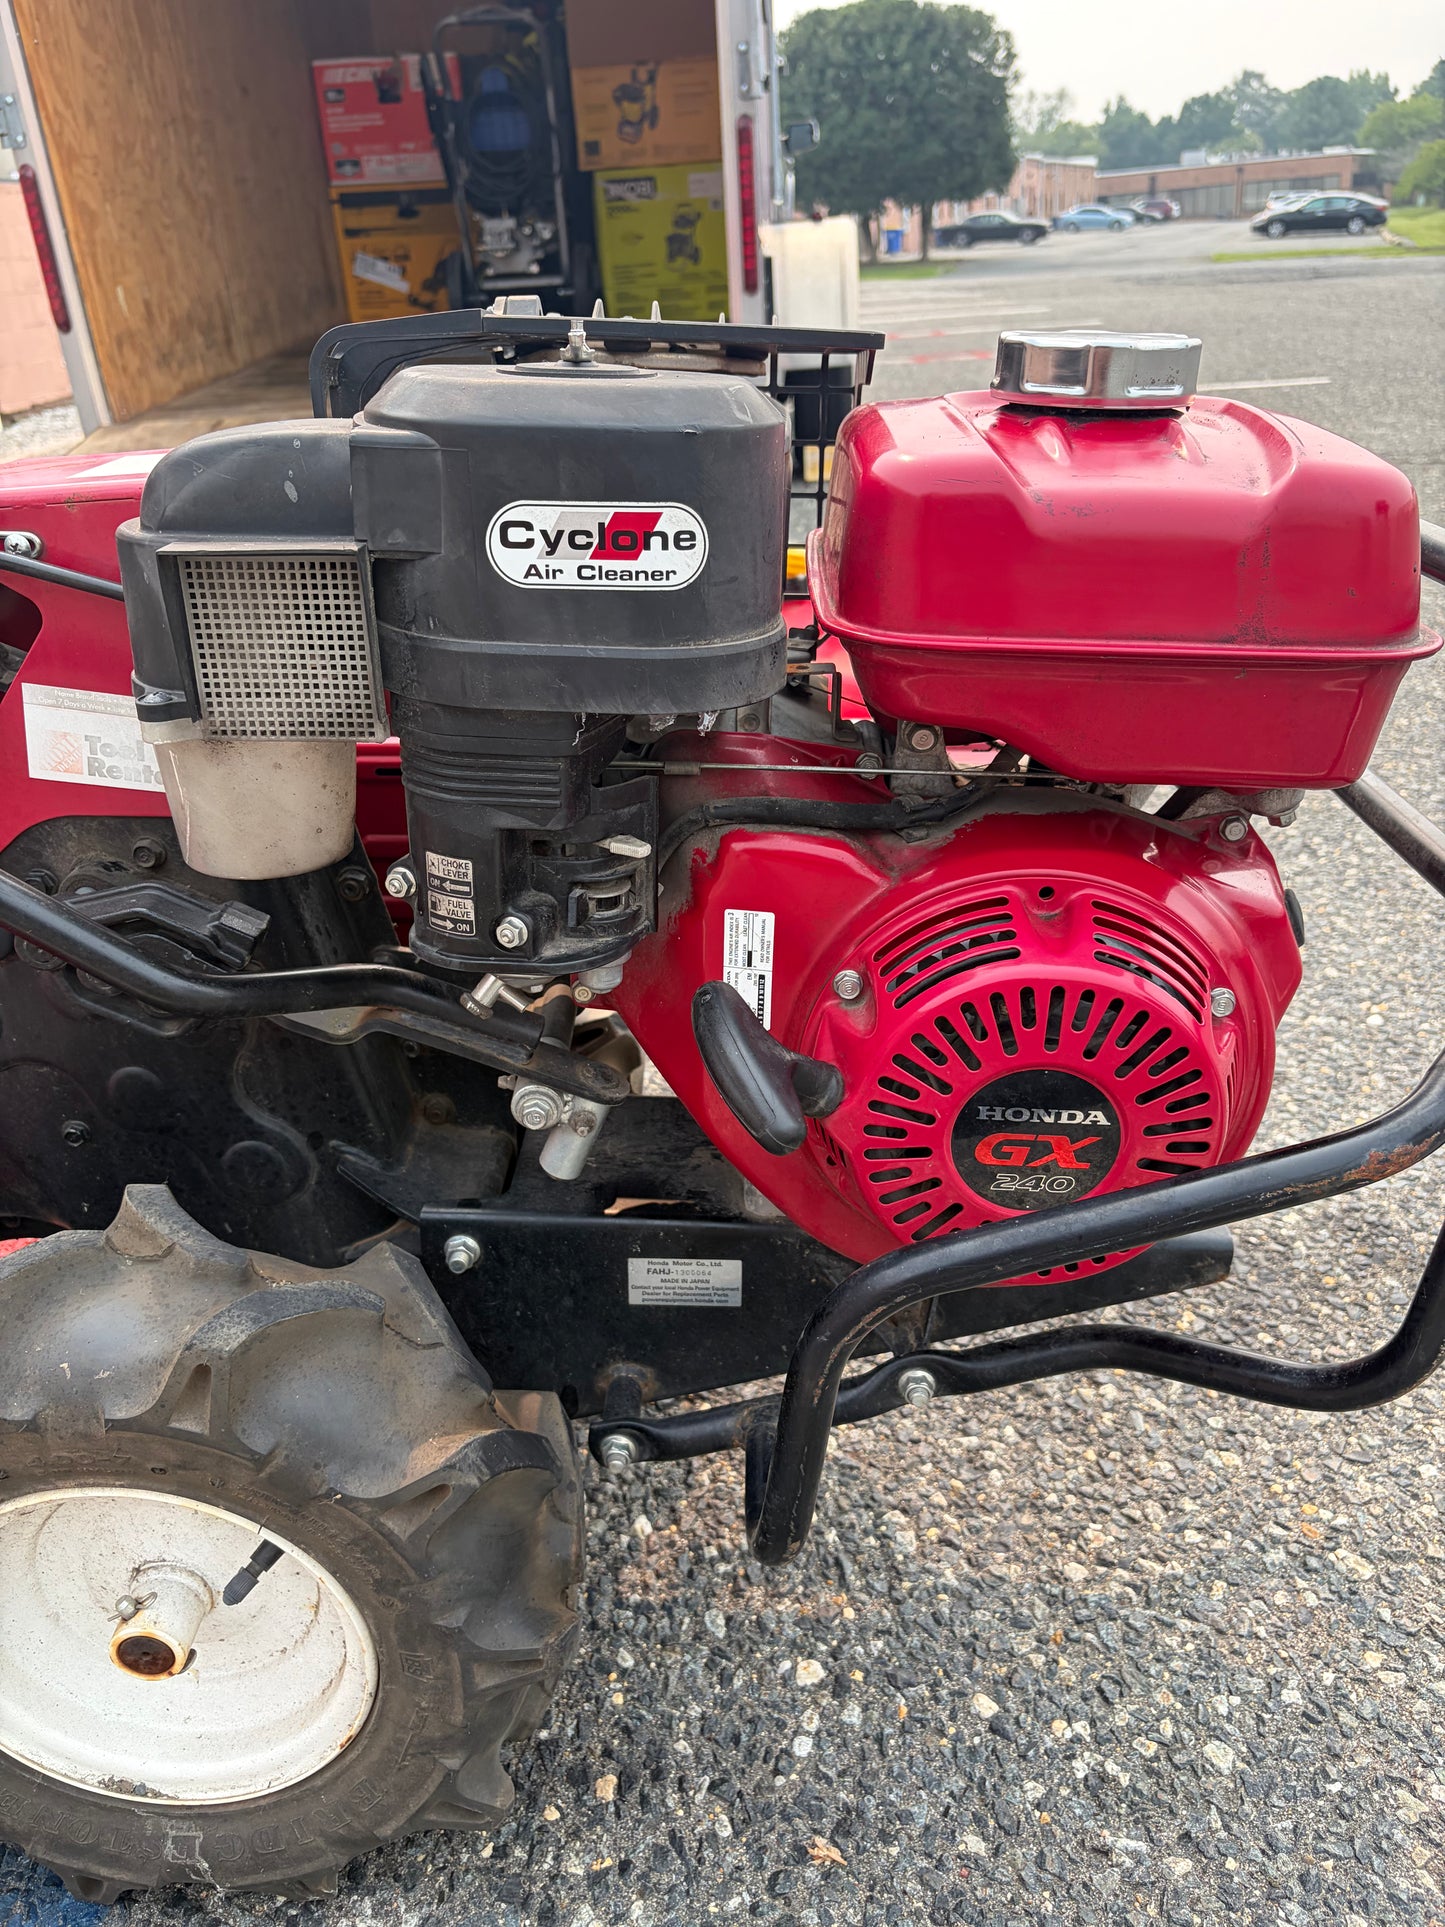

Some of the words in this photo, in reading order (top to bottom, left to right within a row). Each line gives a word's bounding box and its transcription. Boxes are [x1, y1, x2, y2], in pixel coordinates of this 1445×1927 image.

[499, 520, 697, 557] Cyclone
[523, 564, 564, 580] Air
[576, 564, 677, 582] Cleaner
[54, 689, 74, 699] Name
[38, 696, 56, 706] Open
[64, 699, 80, 709] Days
[87, 702, 105, 711] Week
[84, 734, 145, 762] Tool
[441, 858, 470, 871] CHOKE
[443, 867, 469, 880] LEVER
[430, 877, 441, 887] ON
[447, 899, 469, 910] FUEL
[446, 907, 472, 919] VALVE
[456, 923, 470, 932] ON
[976, 1105, 1111, 1126] HONDA
[974, 1132, 1103, 1169] GX
[990, 1173, 1076, 1194] 240
